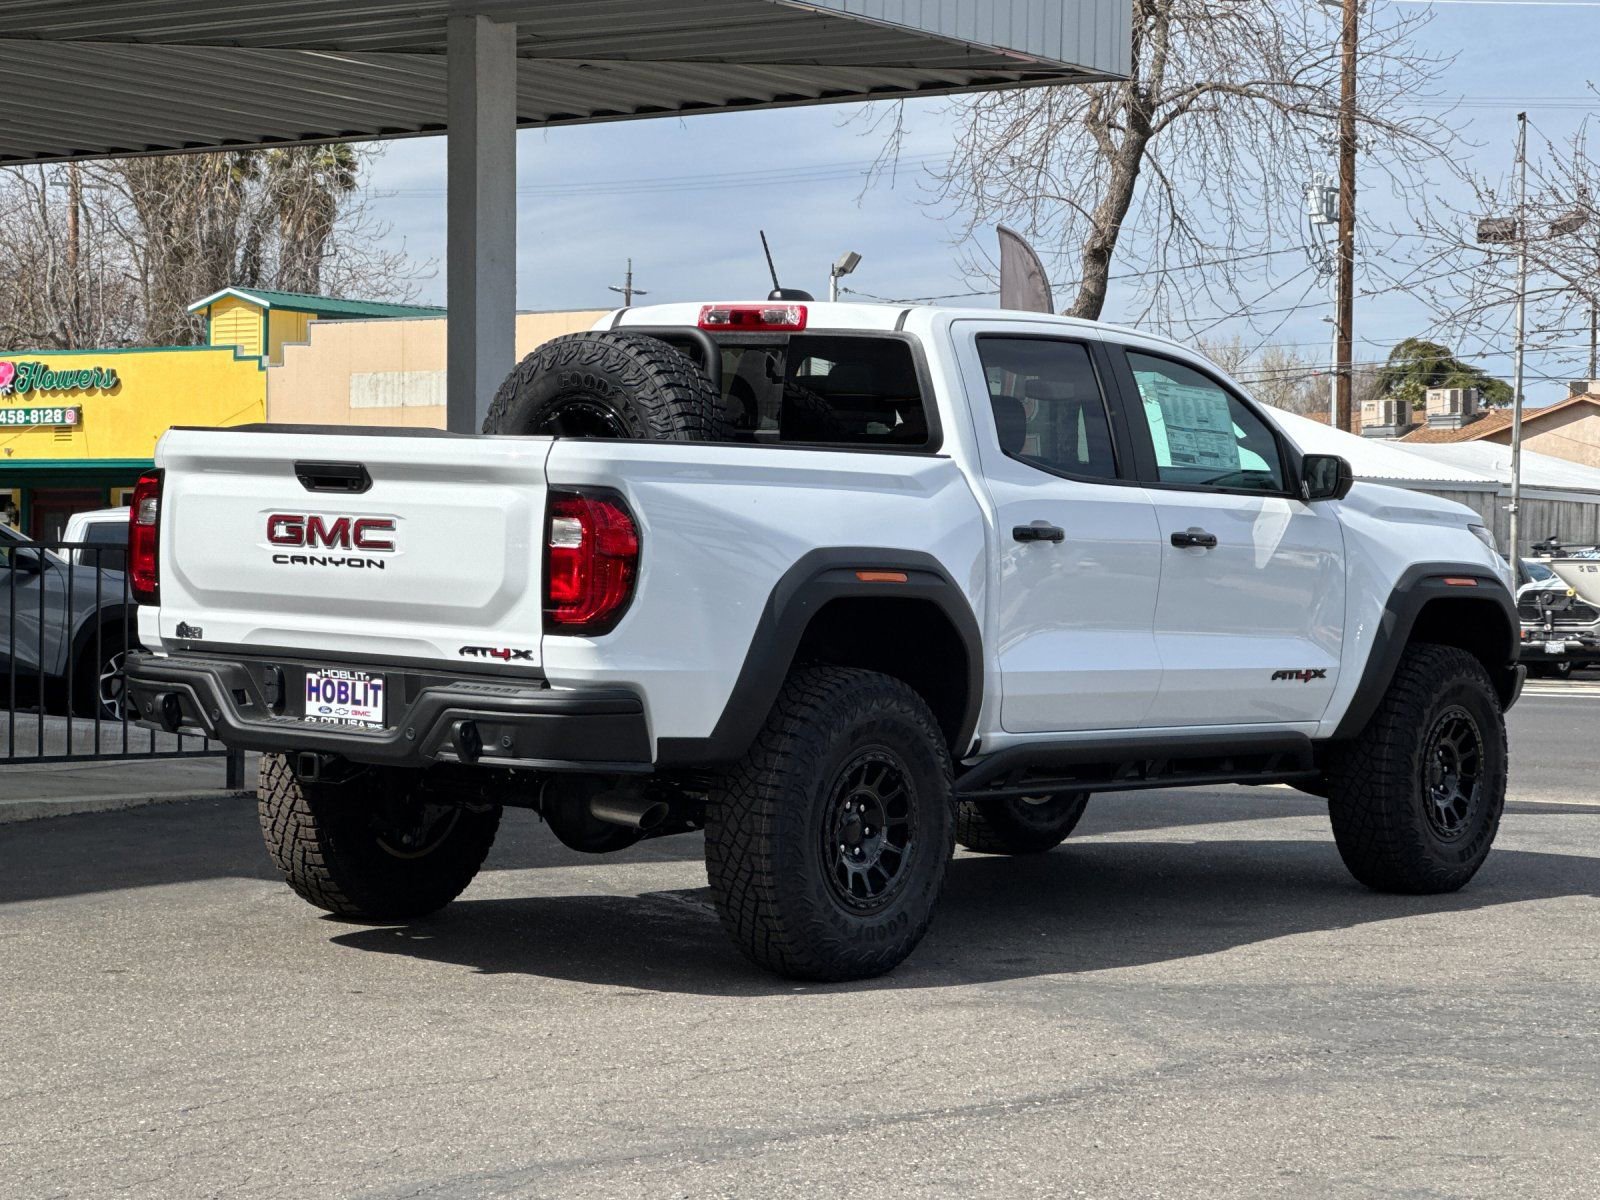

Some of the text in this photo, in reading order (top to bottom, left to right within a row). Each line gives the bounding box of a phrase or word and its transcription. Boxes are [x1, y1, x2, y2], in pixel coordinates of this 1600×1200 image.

[15, 361, 116, 394] Flowers
[266, 513, 397, 552] GMC
[272, 554, 385, 570] CANYON
[458, 645, 534, 662] AT4X
[321, 669, 366, 681] HOBLIT
[1271, 668, 1327, 683] AT4X
[307, 677, 382, 708] HOBLIT
